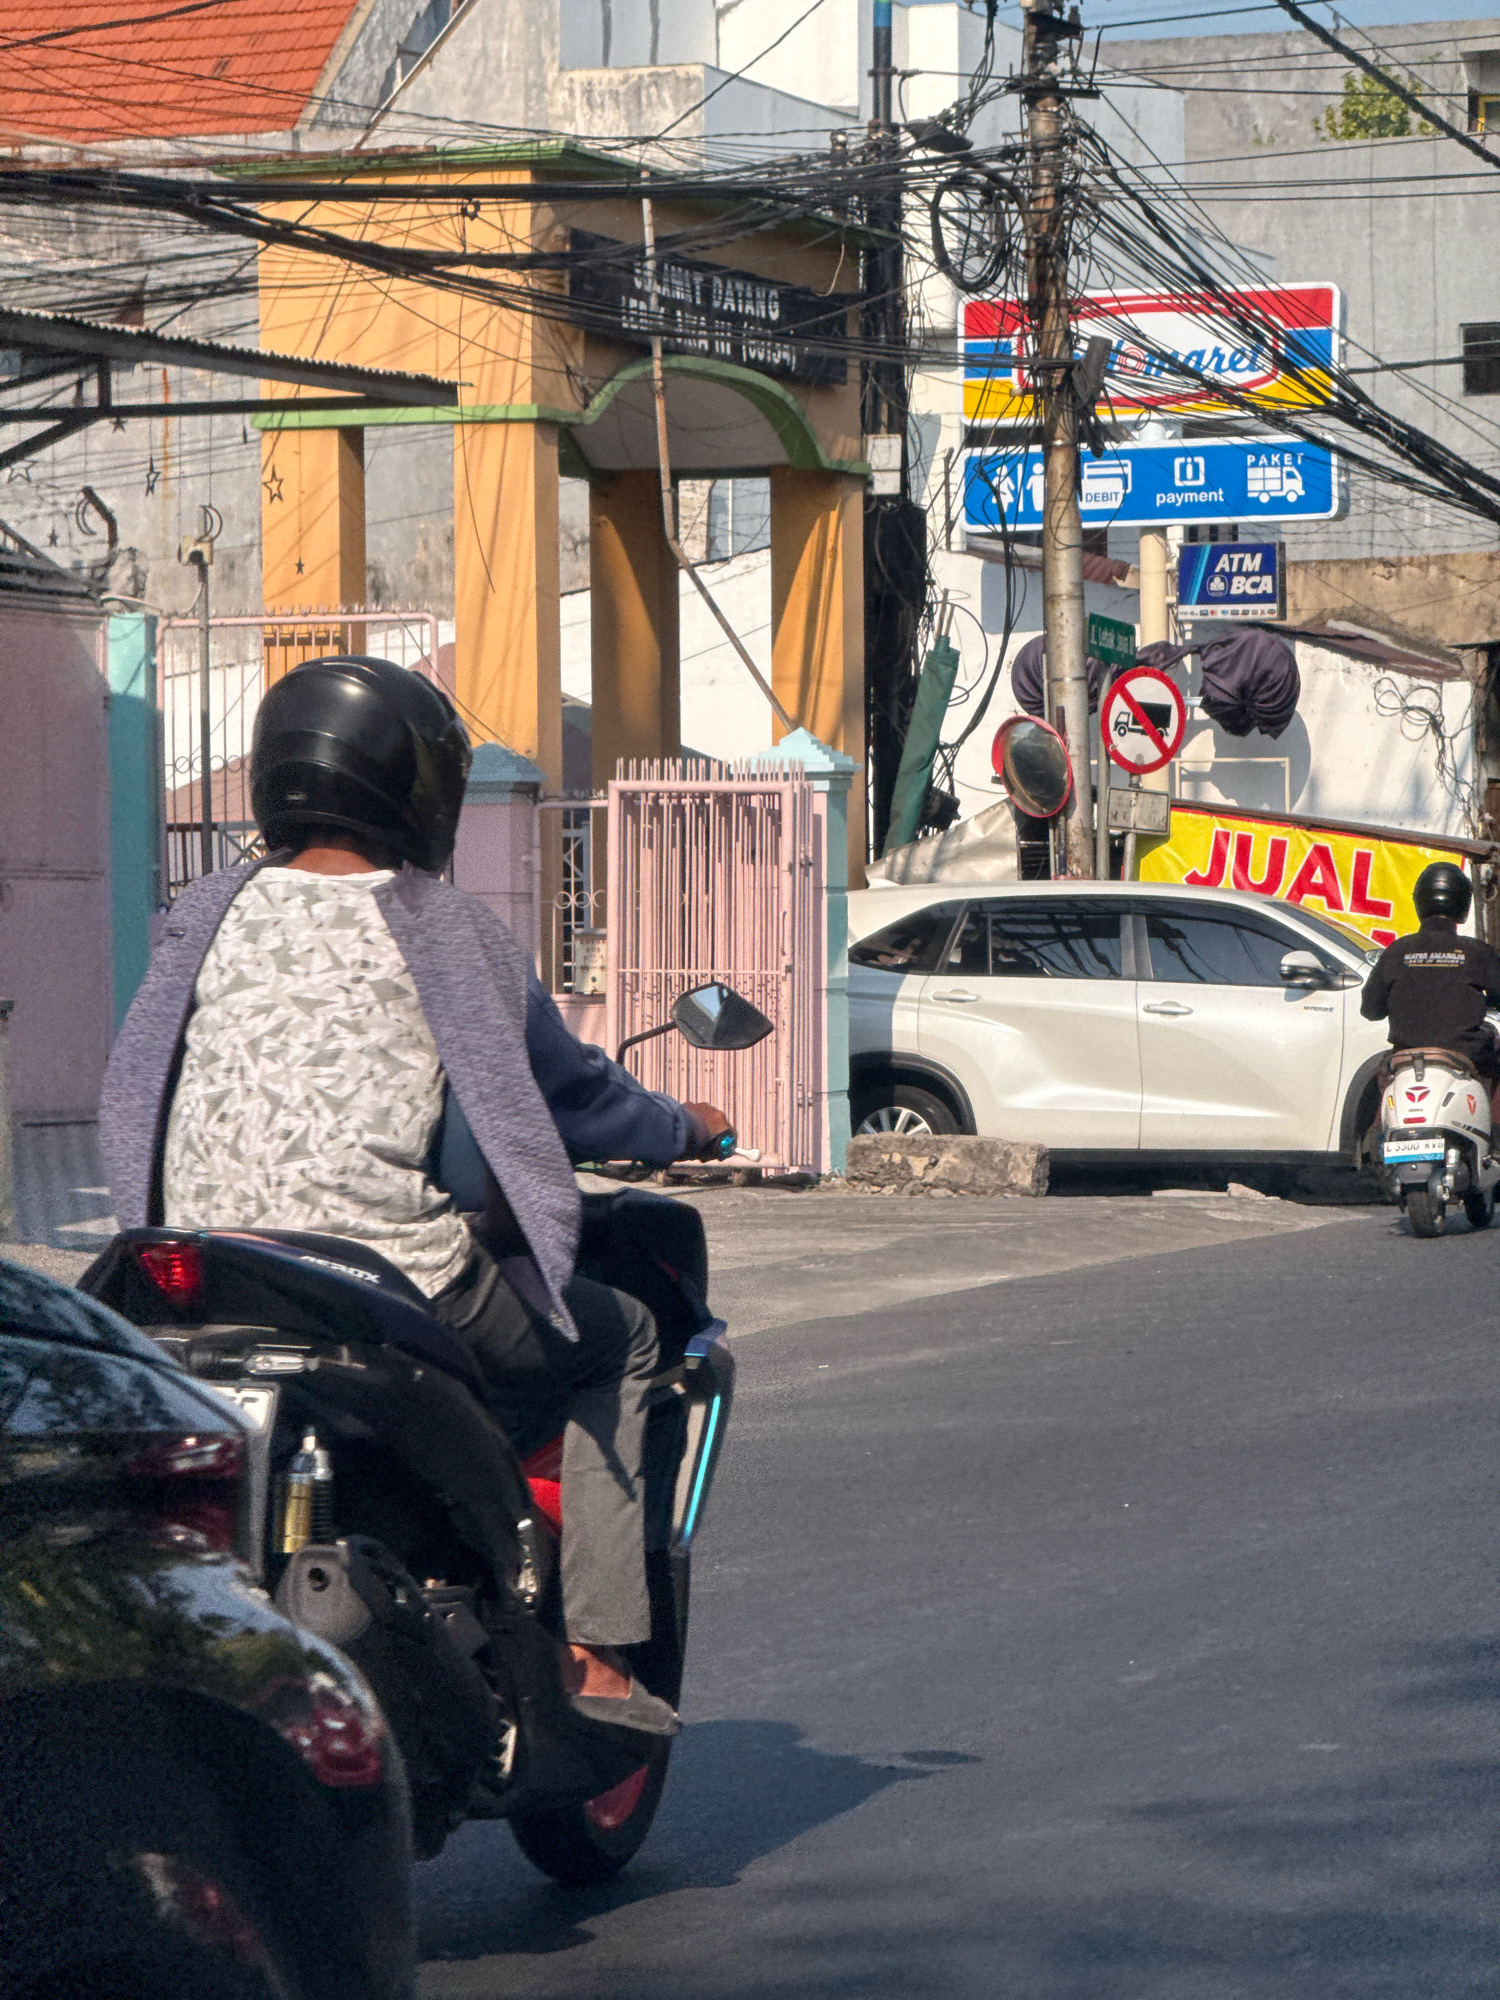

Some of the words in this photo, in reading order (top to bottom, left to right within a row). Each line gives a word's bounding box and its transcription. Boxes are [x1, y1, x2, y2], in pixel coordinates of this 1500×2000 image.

[712, 274, 780, 321] DATANG
[1246, 453, 1304, 466] PAKET
[1085, 492, 1120, 503] DEBIT
[1156, 488, 1225, 507] payment
[1214, 552, 1263, 573] ATM
[1229, 574, 1273, 595] BCA
[1183, 828, 1394, 920] JUAL
